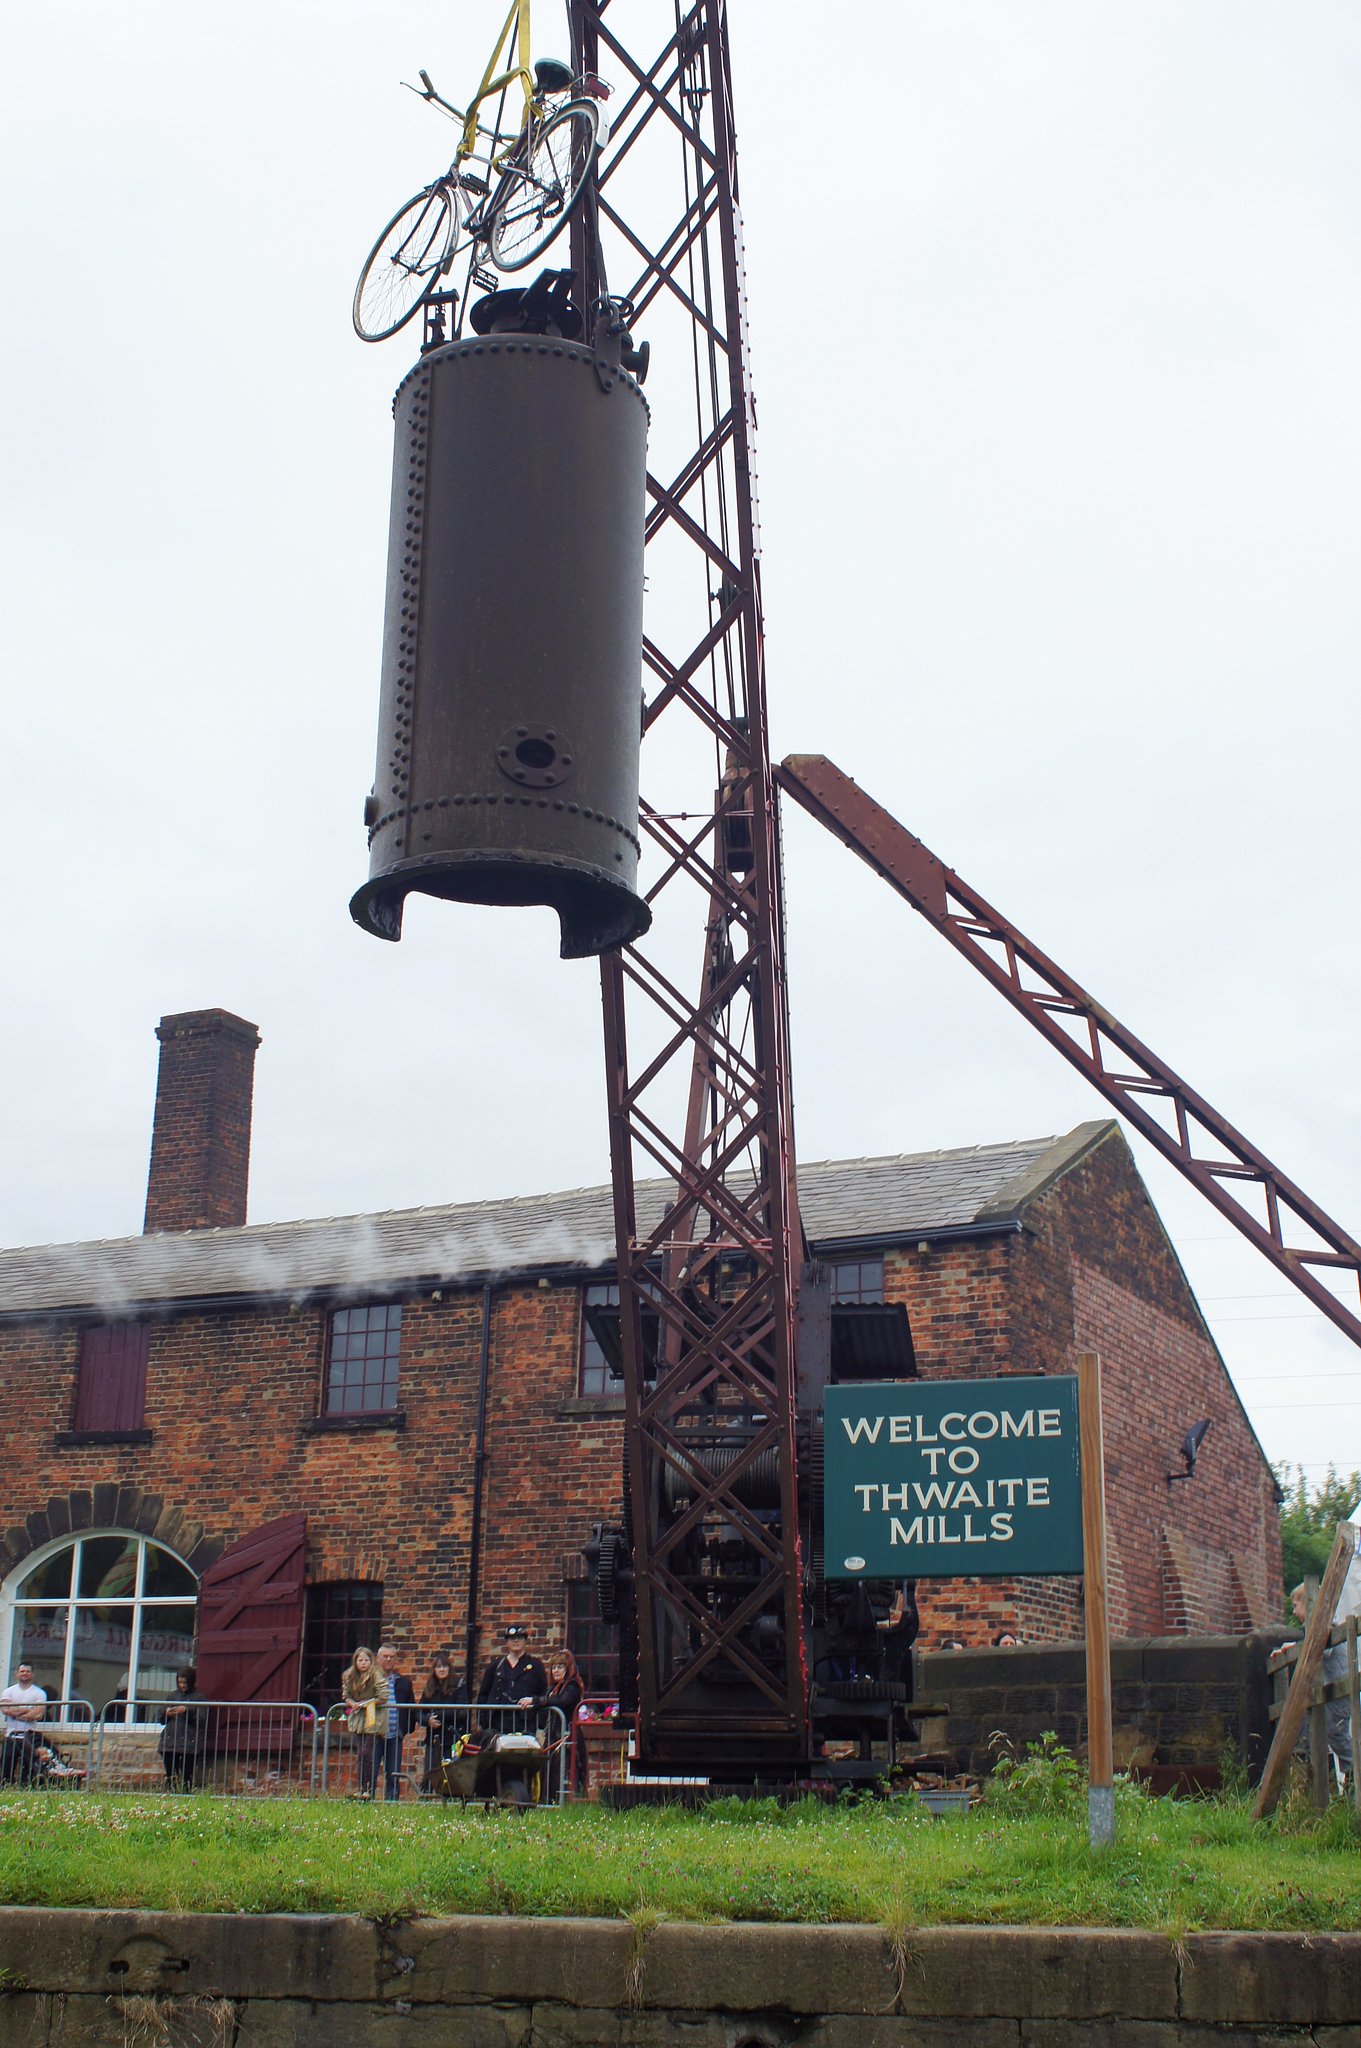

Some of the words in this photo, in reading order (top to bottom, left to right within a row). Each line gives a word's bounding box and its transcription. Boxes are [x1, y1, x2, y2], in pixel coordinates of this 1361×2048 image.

[841, 1409, 1061, 1443] WELCOME
[921, 1446, 979, 1475] TO
[854, 1477, 1050, 1511] THWAITE
[890, 1512, 1014, 1544] MILLS
